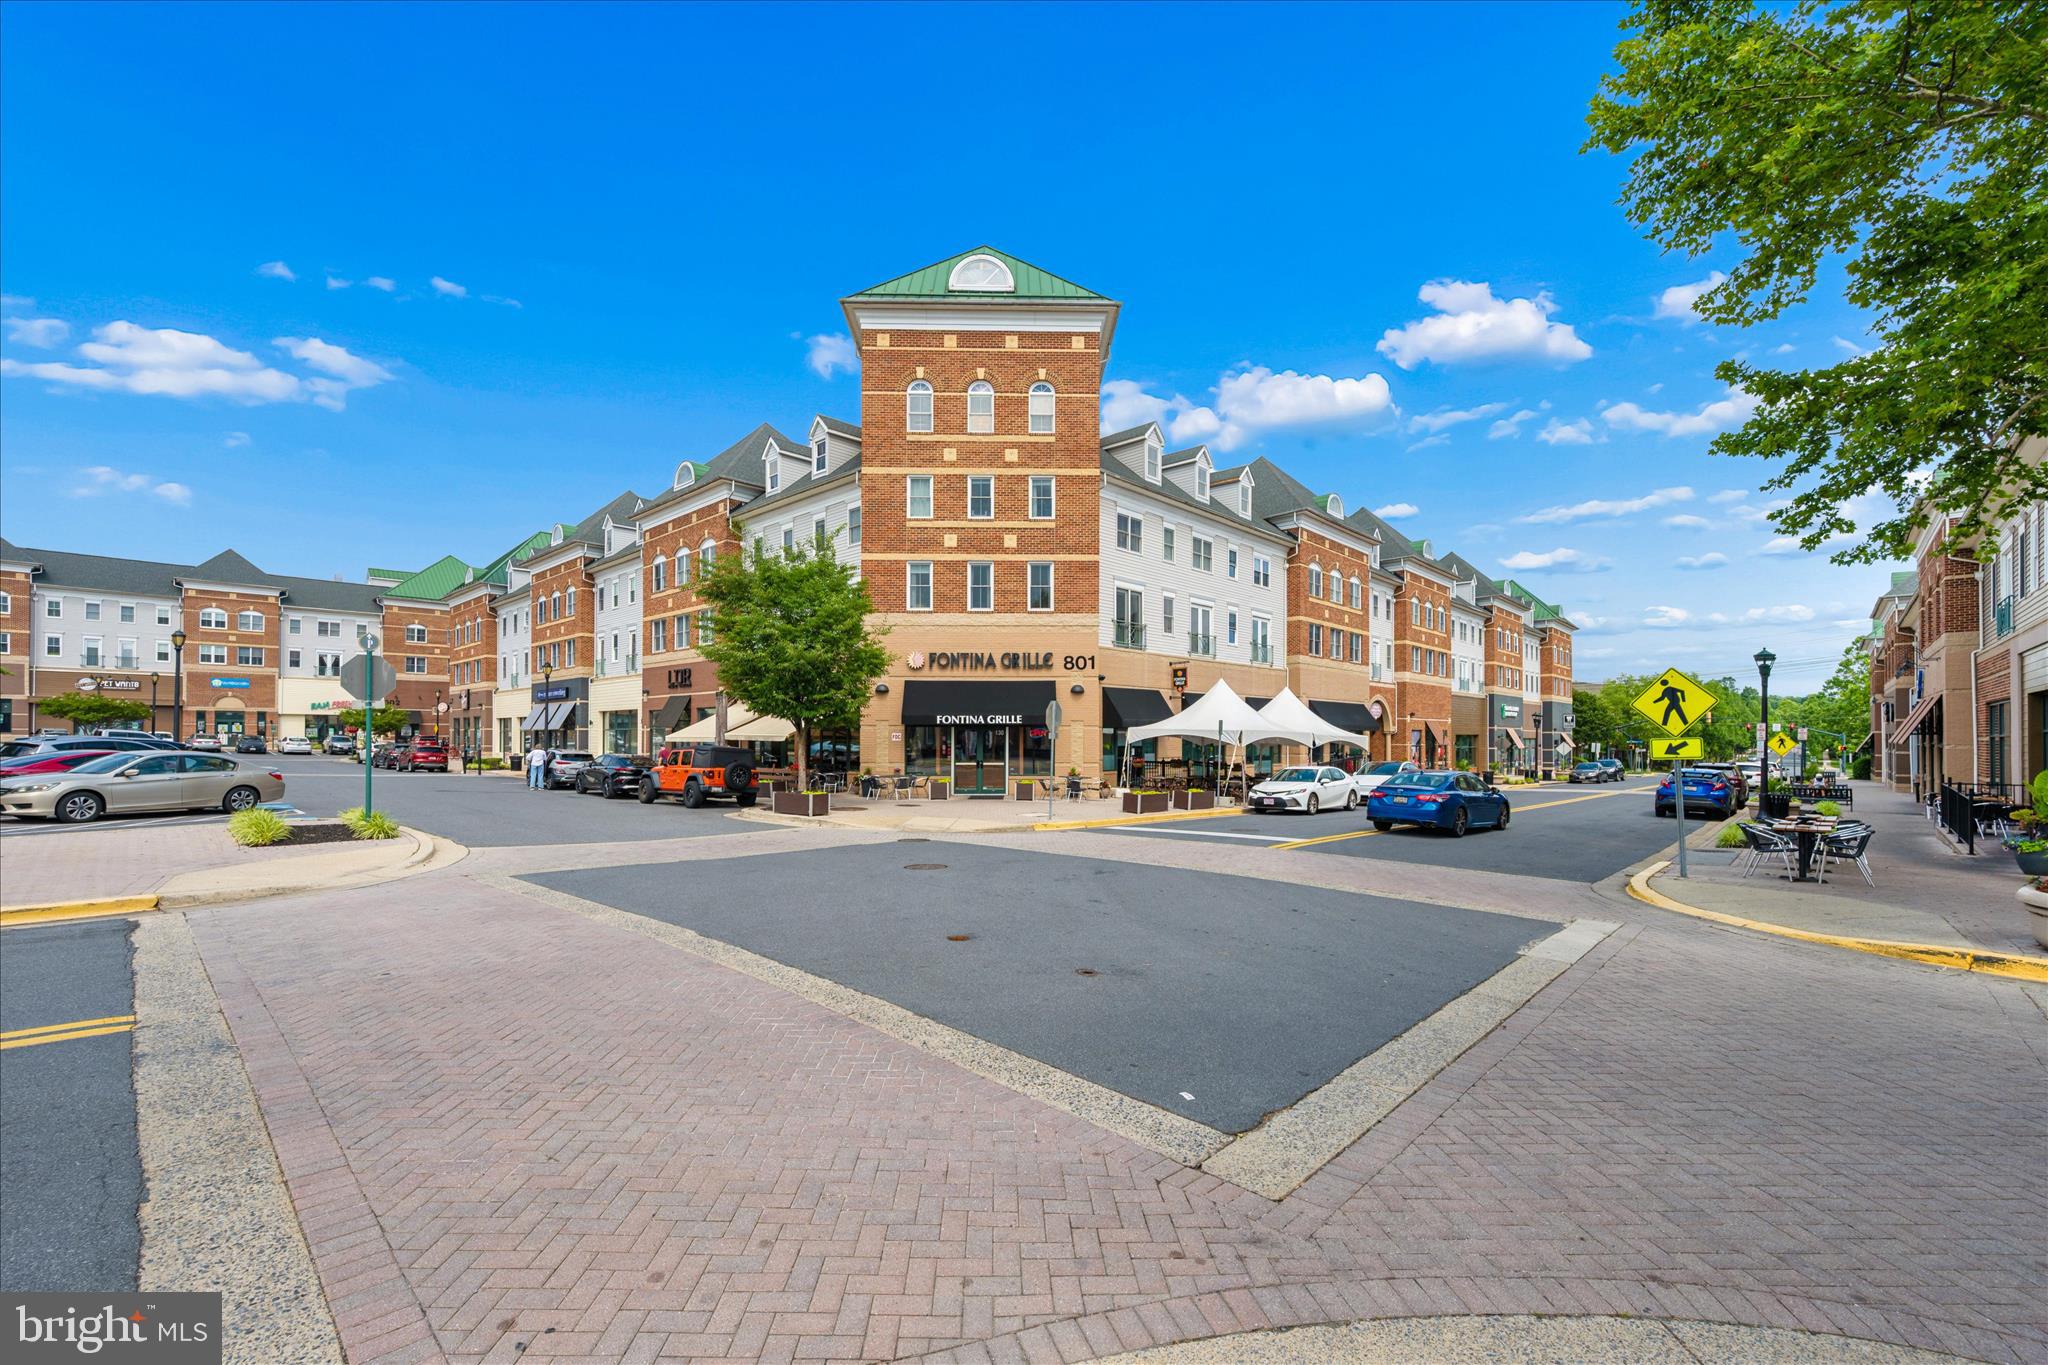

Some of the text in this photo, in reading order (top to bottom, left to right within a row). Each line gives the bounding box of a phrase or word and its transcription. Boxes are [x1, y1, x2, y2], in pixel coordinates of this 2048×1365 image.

[928, 652, 1054, 670] FONTINA GRILLE
[1063, 655, 1095, 671] 801
[936, 715, 1023, 724] FONTINA GRILLE
